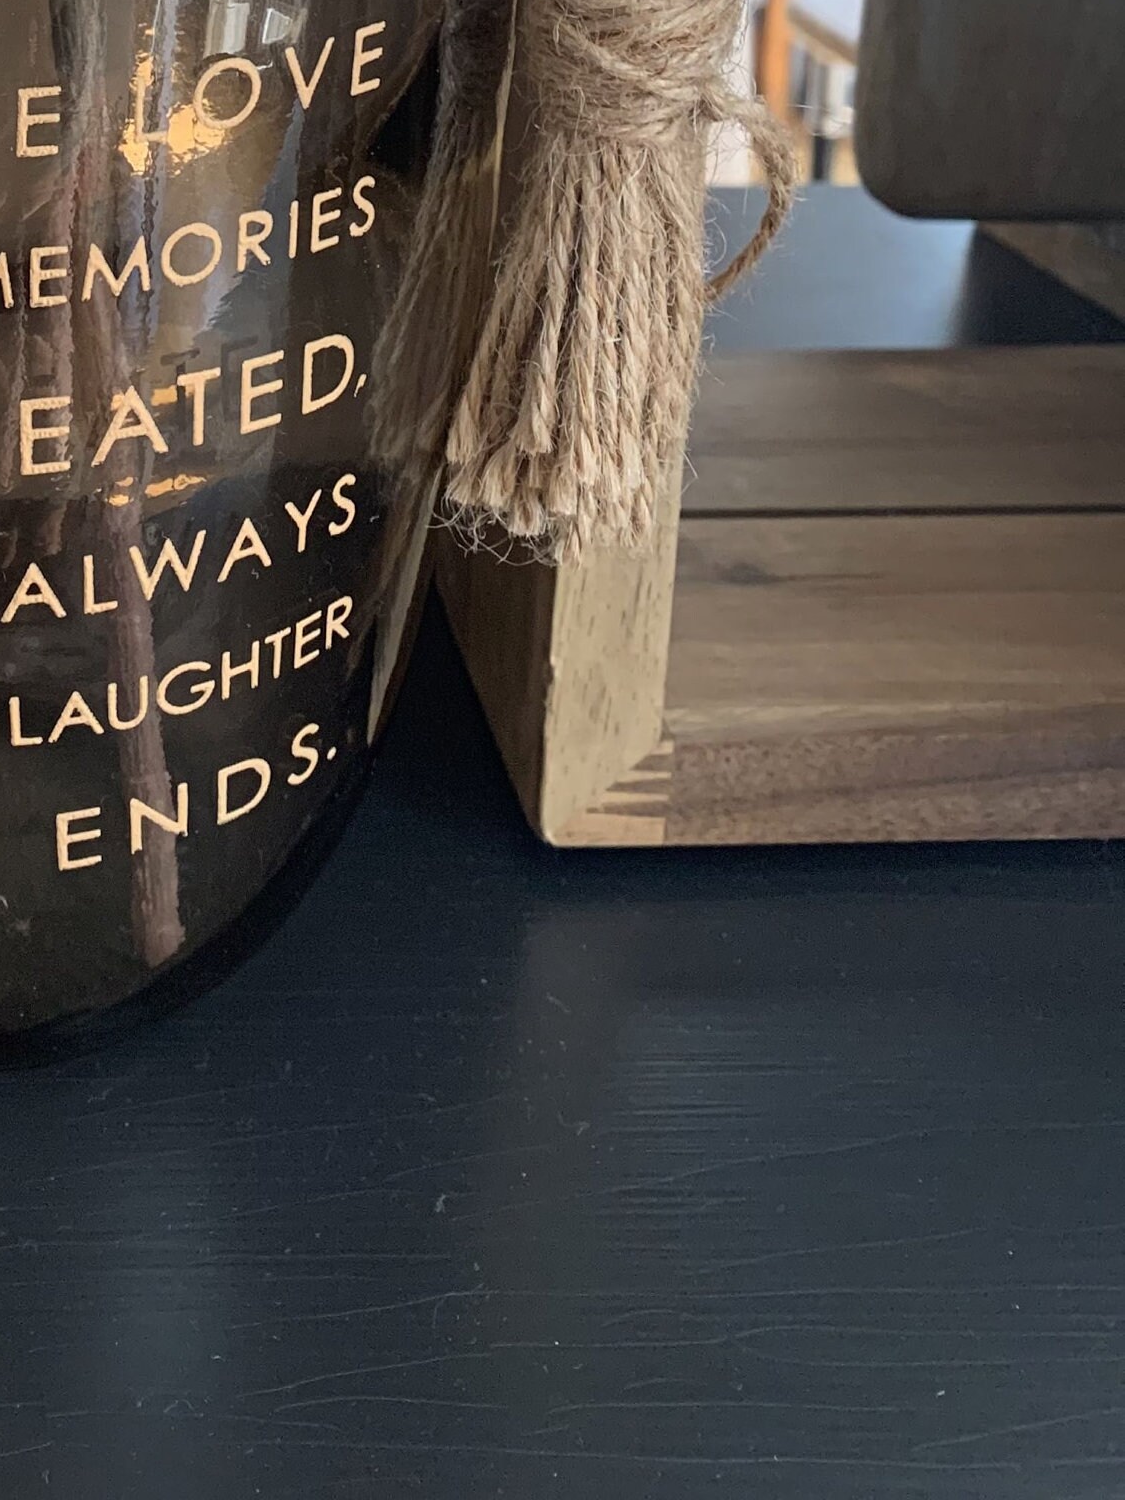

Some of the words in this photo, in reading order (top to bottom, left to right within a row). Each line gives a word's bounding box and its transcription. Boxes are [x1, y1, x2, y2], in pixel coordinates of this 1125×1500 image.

[132, 20, 387, 144] LOVE
[0, 472, 358, 623] ALWAYS
[9, 594, 355, 747] LAUGHTER
[56, 722, 338, 873] ENDS.
